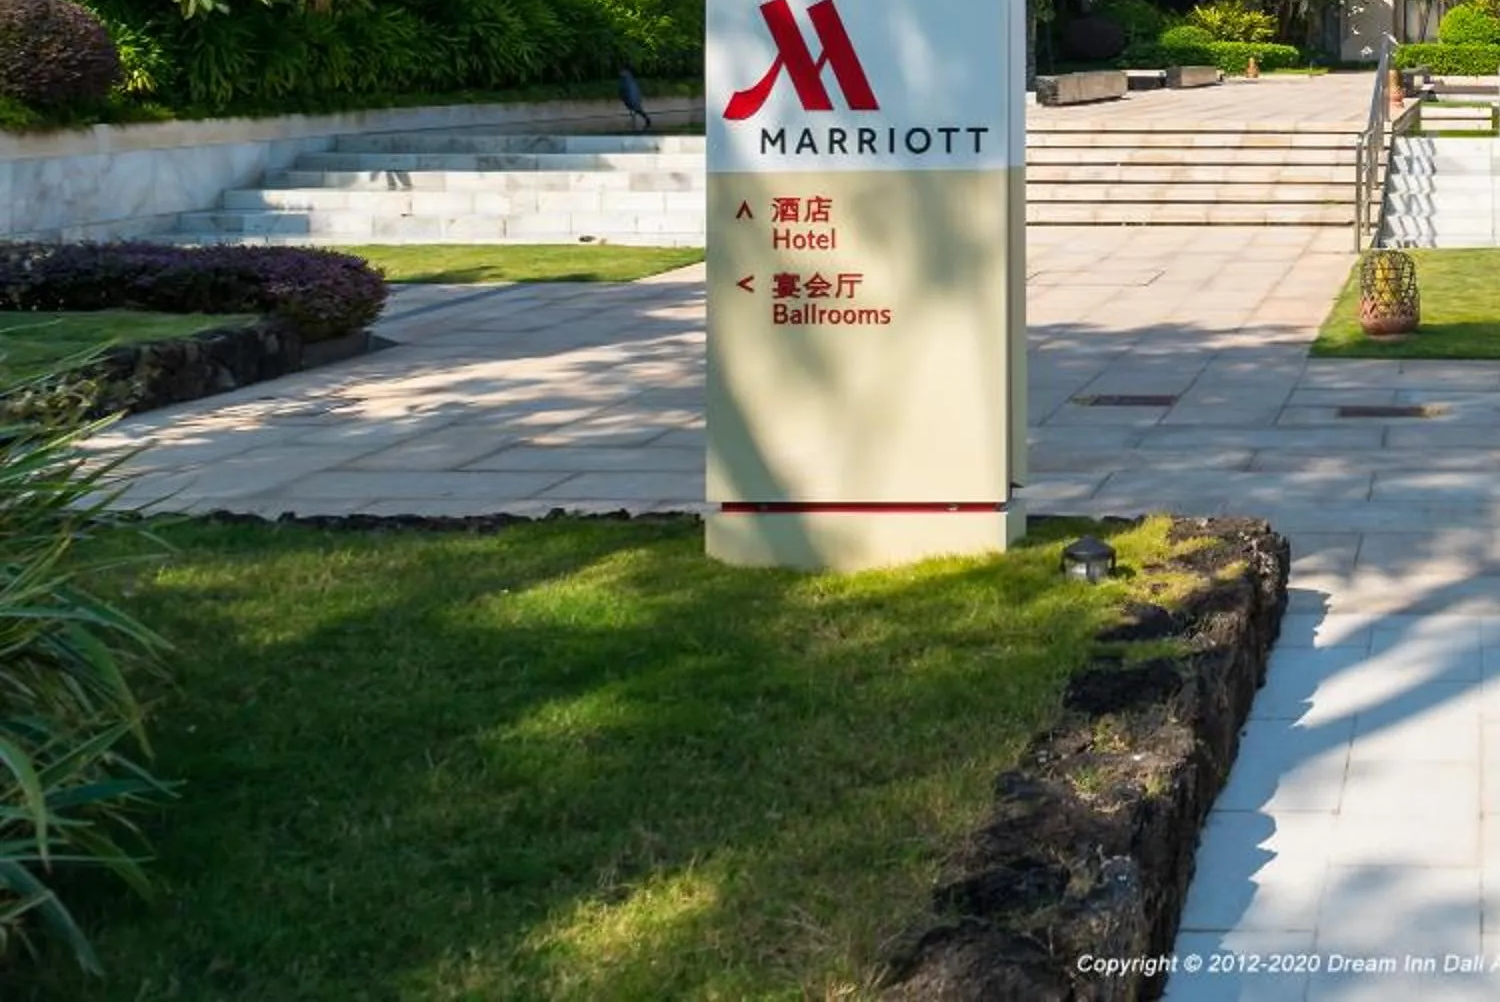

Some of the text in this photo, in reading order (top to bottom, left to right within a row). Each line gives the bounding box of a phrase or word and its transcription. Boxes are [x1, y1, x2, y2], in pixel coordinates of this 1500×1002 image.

[760, 127, 989, 154] MARRIOTT
[771, 196, 833, 223] 酒店
[772, 228, 836, 250] Hotel
[772, 273, 863, 299] 宴会厅
[773, 304, 891, 325] Ballrooms
